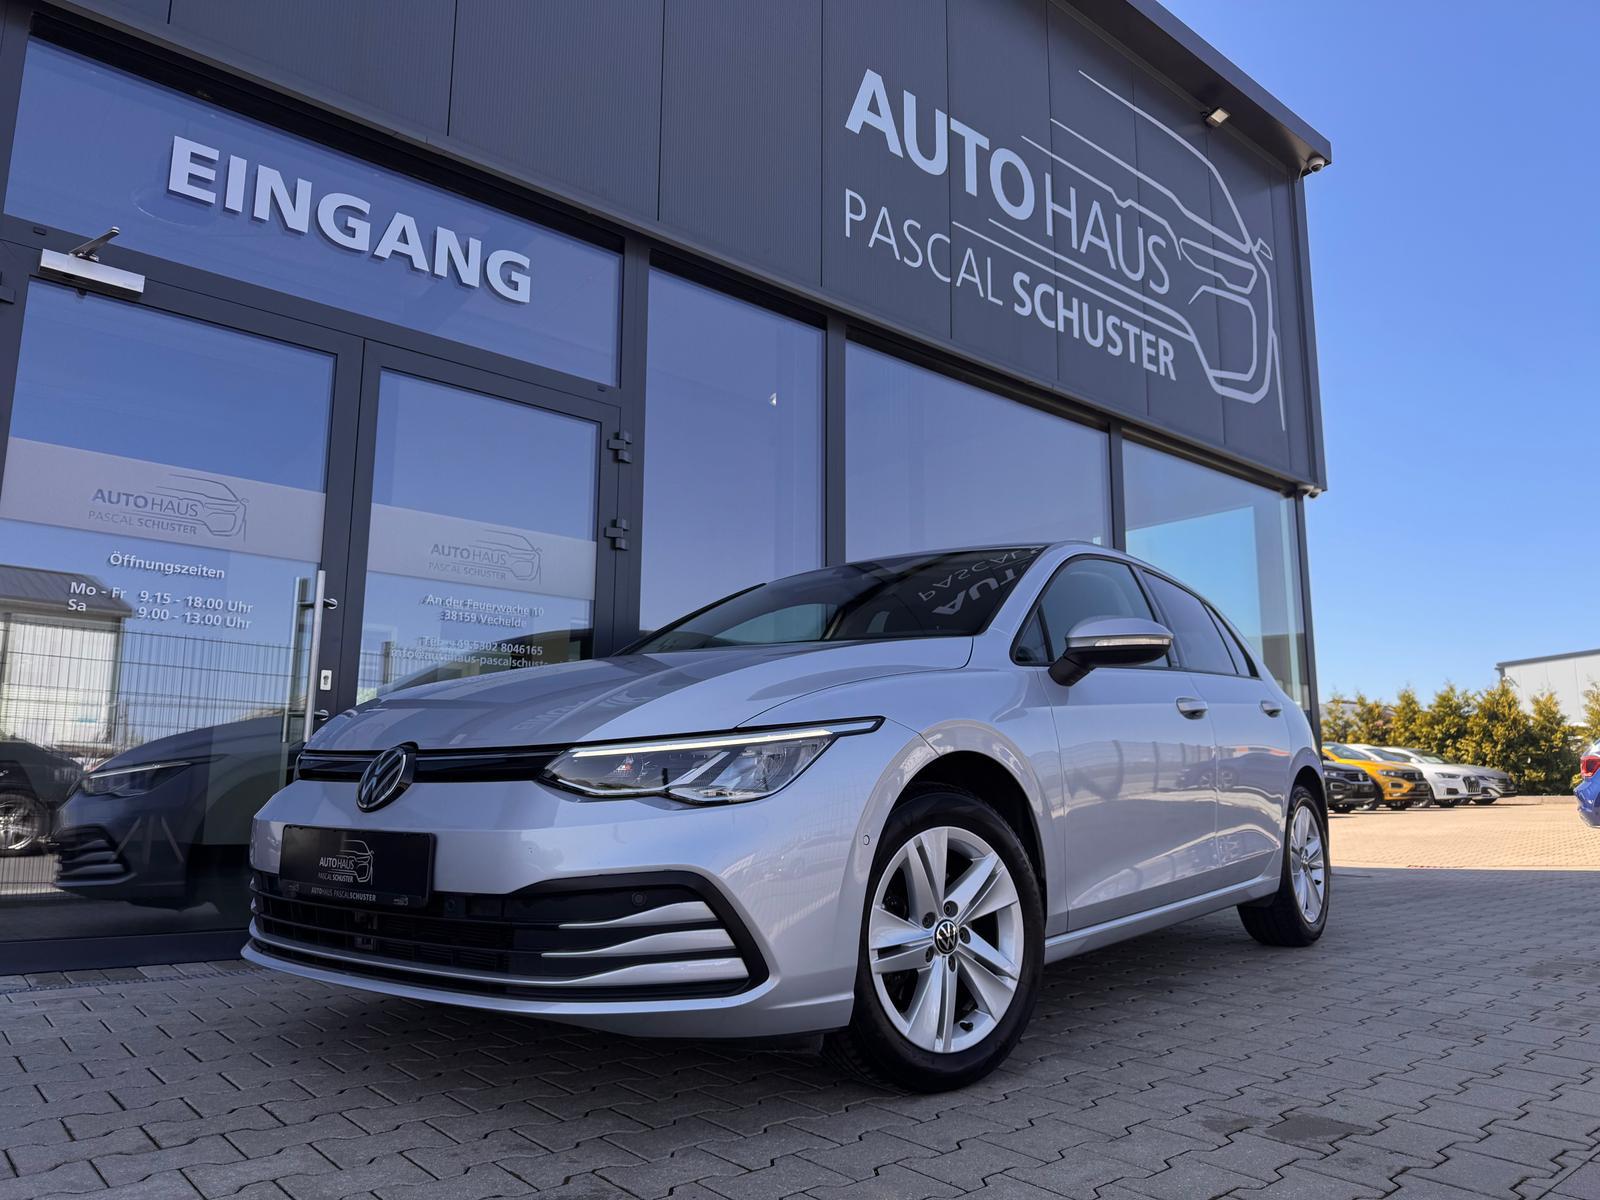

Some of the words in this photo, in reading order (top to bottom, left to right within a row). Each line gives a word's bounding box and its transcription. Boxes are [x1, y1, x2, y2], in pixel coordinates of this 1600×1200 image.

[844, 68, 1170, 295] AUTOHAUS
[167, 135, 531, 303] EINGANG
[845, 188, 1003, 306] PASCAL
[1013, 271, 1177, 381] SCHUSTER
[92, 488, 199, 517] AUTOHAUS
[88, 510, 134, 526] PASCAL
[137, 518, 197, 535] SCHUSTER
[110, 551, 225, 579] Öffnungszeiten
[430, 543, 507, 566] AUTOHAUS
[428, 561, 460, 575] PASCAL
[463, 566, 507, 581] SCHUSTER
[70, 581, 97, 596] Mo
[111, 587, 127, 599] Fr
[139, 590, 172, 605] 9.15
[186, 596, 224, 610] 18.00
[227, 600, 253, 614] Uhr
[426, 594, 443, 606] An
[446, 596, 463, 609] der
[467, 599, 530, 616] Feuerwache
[533, 606, 544, 617] 10
[68, 599, 87, 612] Sa
[137, 607, 170, 620] 9.00
[184, 612, 222, 626] 13.00
[226, 617, 252, 630] Uhr
[445, 609, 477, 623] 38159
[480, 613, 527, 628] Vechelde
[501, 642, 543, 656] 8046165
[319, 856, 355, 870] AUTOHAUS
[333, 874, 354, 883] SCHUSTER
[350, 892, 376, 901] SCHUSTER
